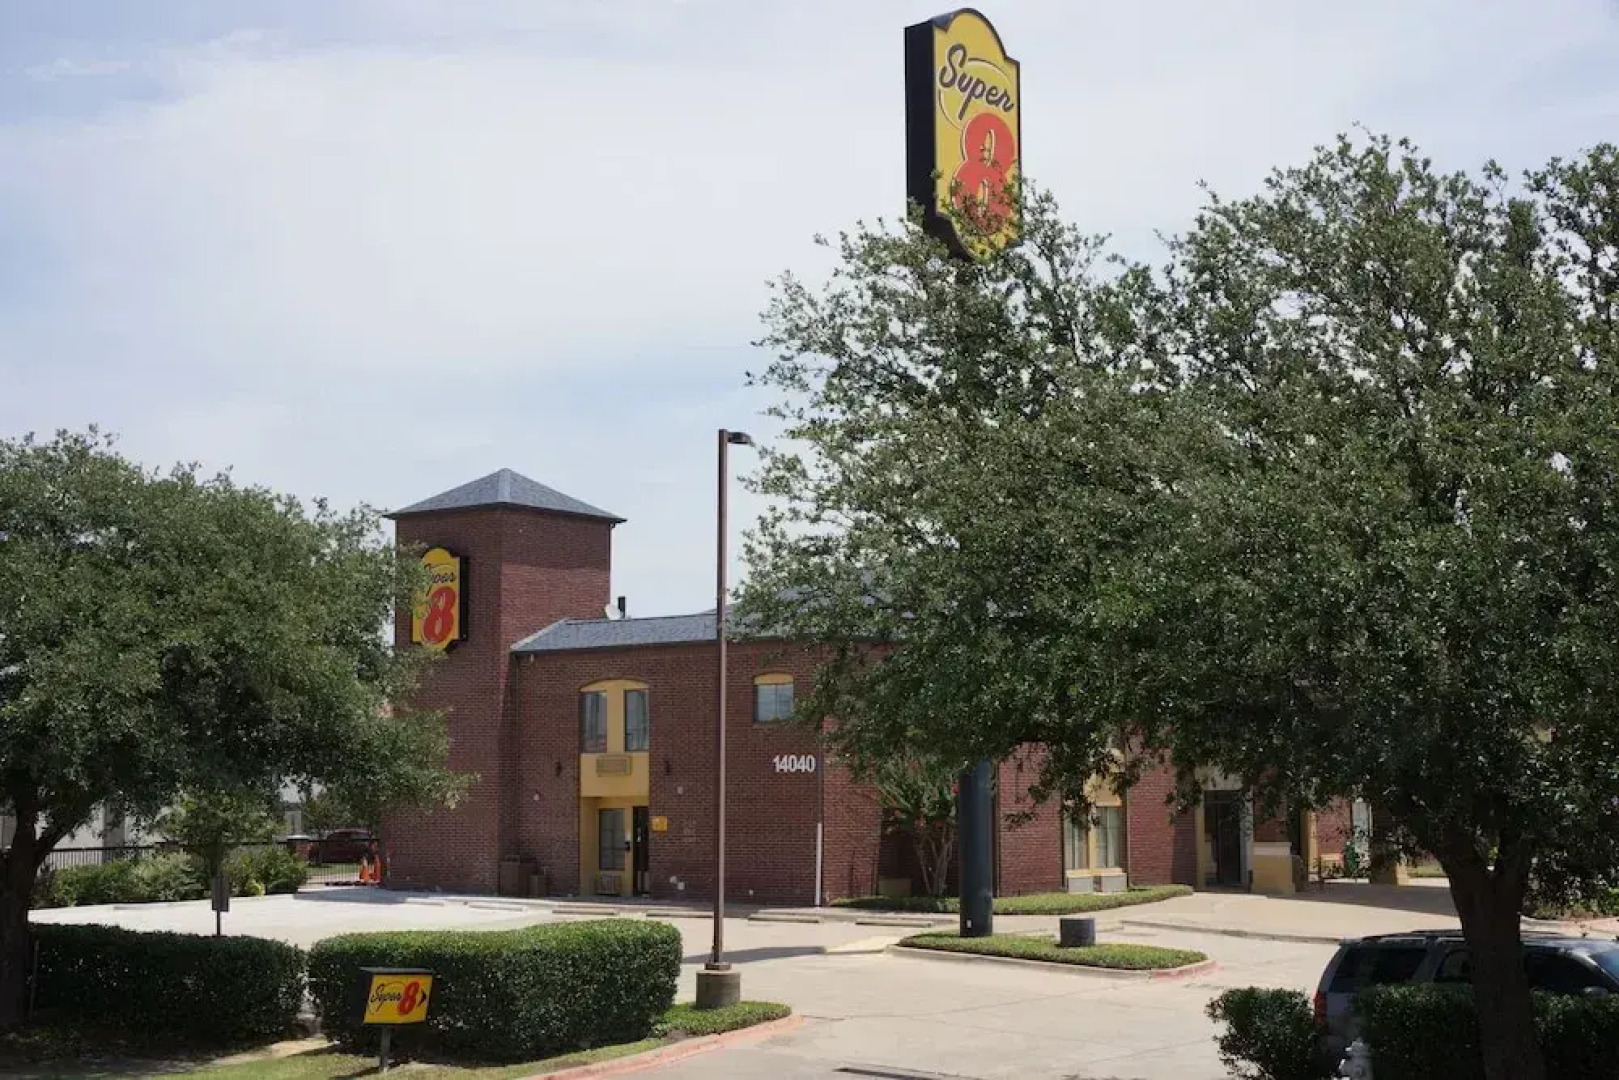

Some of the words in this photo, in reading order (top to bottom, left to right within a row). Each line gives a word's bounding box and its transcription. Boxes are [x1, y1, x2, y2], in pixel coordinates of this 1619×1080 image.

[938, 43, 1014, 121] Super
[952, 112, 1016, 236] 8
[423, 586, 456, 644] 8
[773, 754, 817, 773] 14040
[370, 982, 402, 1012] Super
[398, 980, 420, 1015] 8
